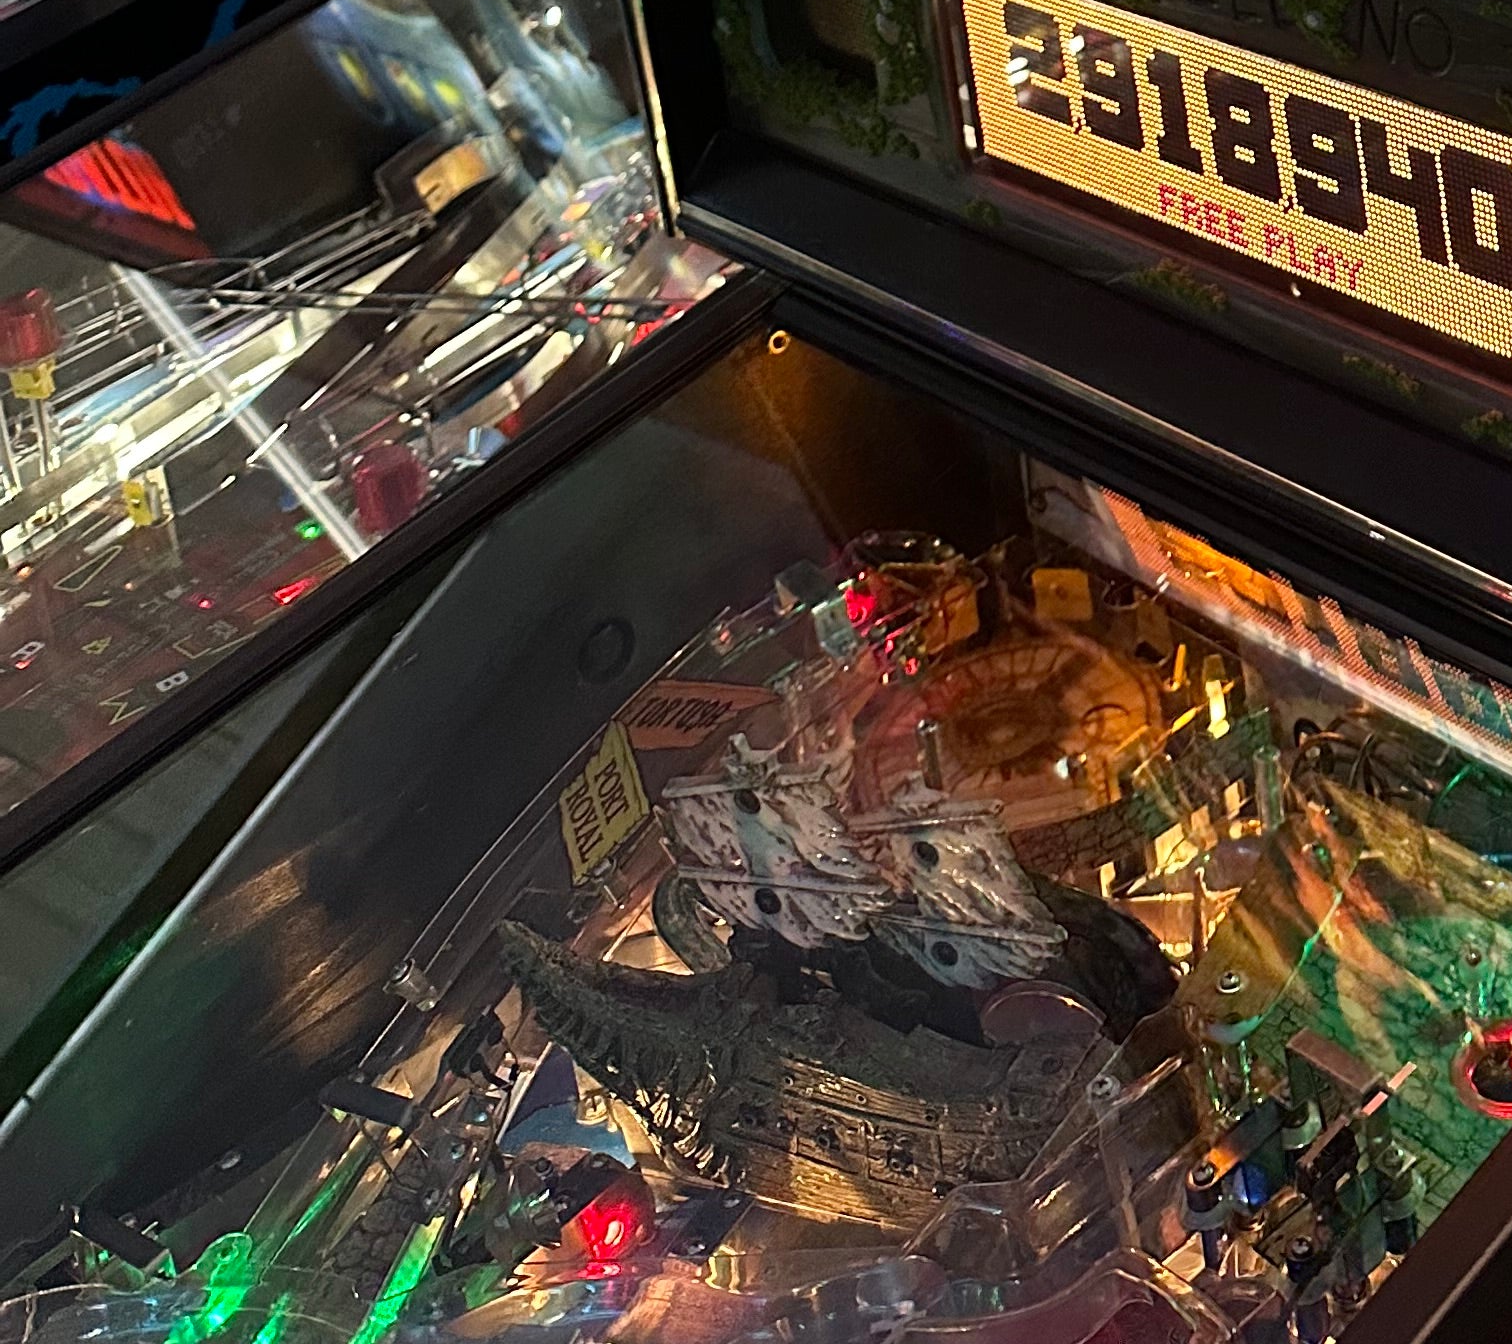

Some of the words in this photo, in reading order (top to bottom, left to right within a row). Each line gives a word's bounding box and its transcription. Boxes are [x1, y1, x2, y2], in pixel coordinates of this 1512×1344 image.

[1156, 183, 1250, 250] FREE
[1262, 222, 1364, 292] PLAY
[565, 783, 605, 864] ROYAL
[593, 758, 631, 826] PORT
